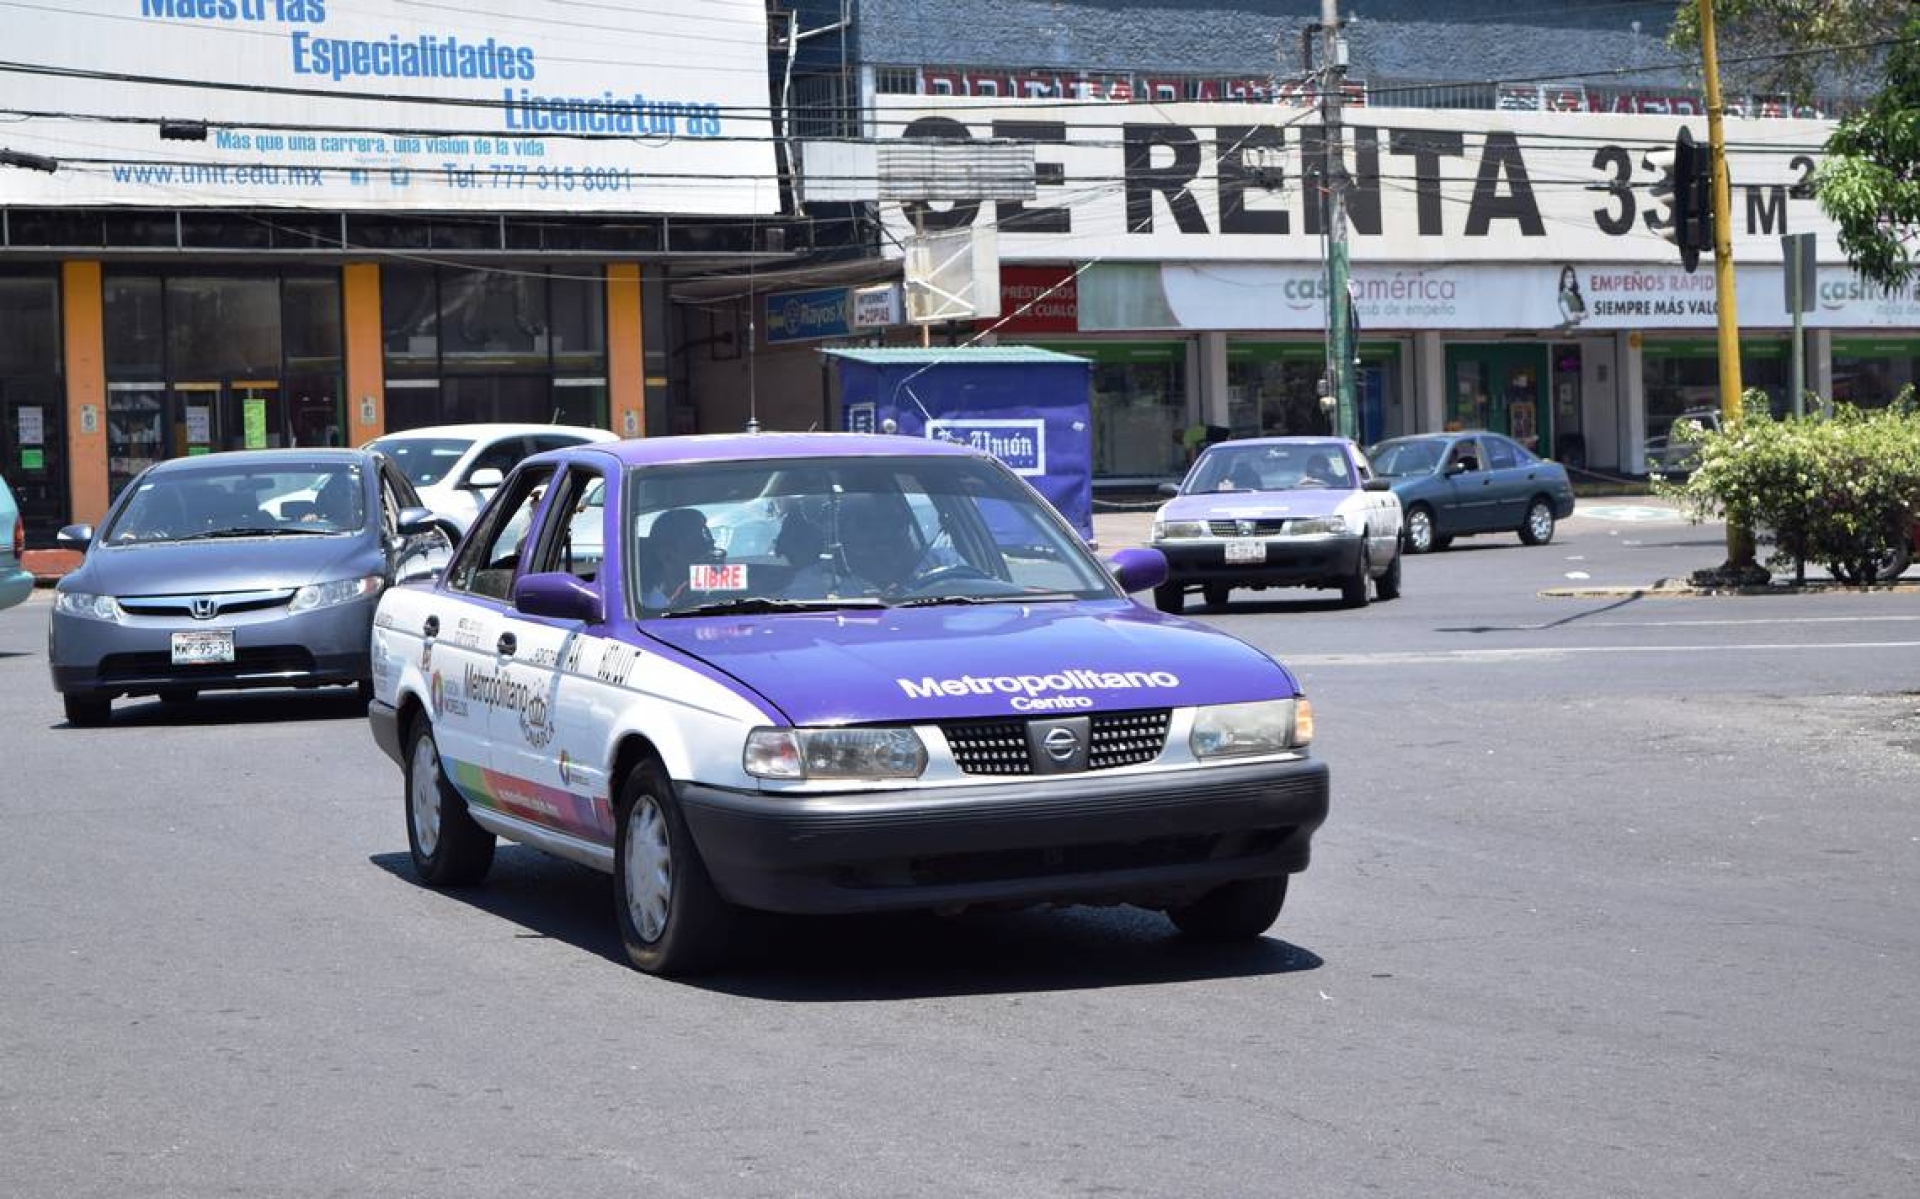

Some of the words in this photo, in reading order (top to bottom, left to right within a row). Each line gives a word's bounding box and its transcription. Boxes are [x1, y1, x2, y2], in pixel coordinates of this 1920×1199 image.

[292, 31, 535, 81] Especialidades
[504, 88, 721, 136] Licenciaturas
[256, 135, 284, 153] que
[288, 136, 316, 151] una
[394, 139, 420, 153] una
[475, 139, 491, 154] de
[497, 138, 509, 155] la
[514, 140, 545, 156] vida
[112, 163, 323, 186] www.unit.edu.mx
[443, 163, 483, 188] Tel.
[489, 164, 527, 189] 777
[537, 165, 575, 191] 315
[583, 166, 632, 192] 8001
[1123, 123, 1547, 236] RENTA
[1591, 270, 1664, 292] EMPEÑOS
[1594, 299, 1650, 316] SIEMPRE
[1654, 296, 1685, 316] MÁS
[694, 566, 742, 588] LIBRE
[896, 669, 1180, 698] Metropolitano
[1010, 696, 1094, 711] Centro
